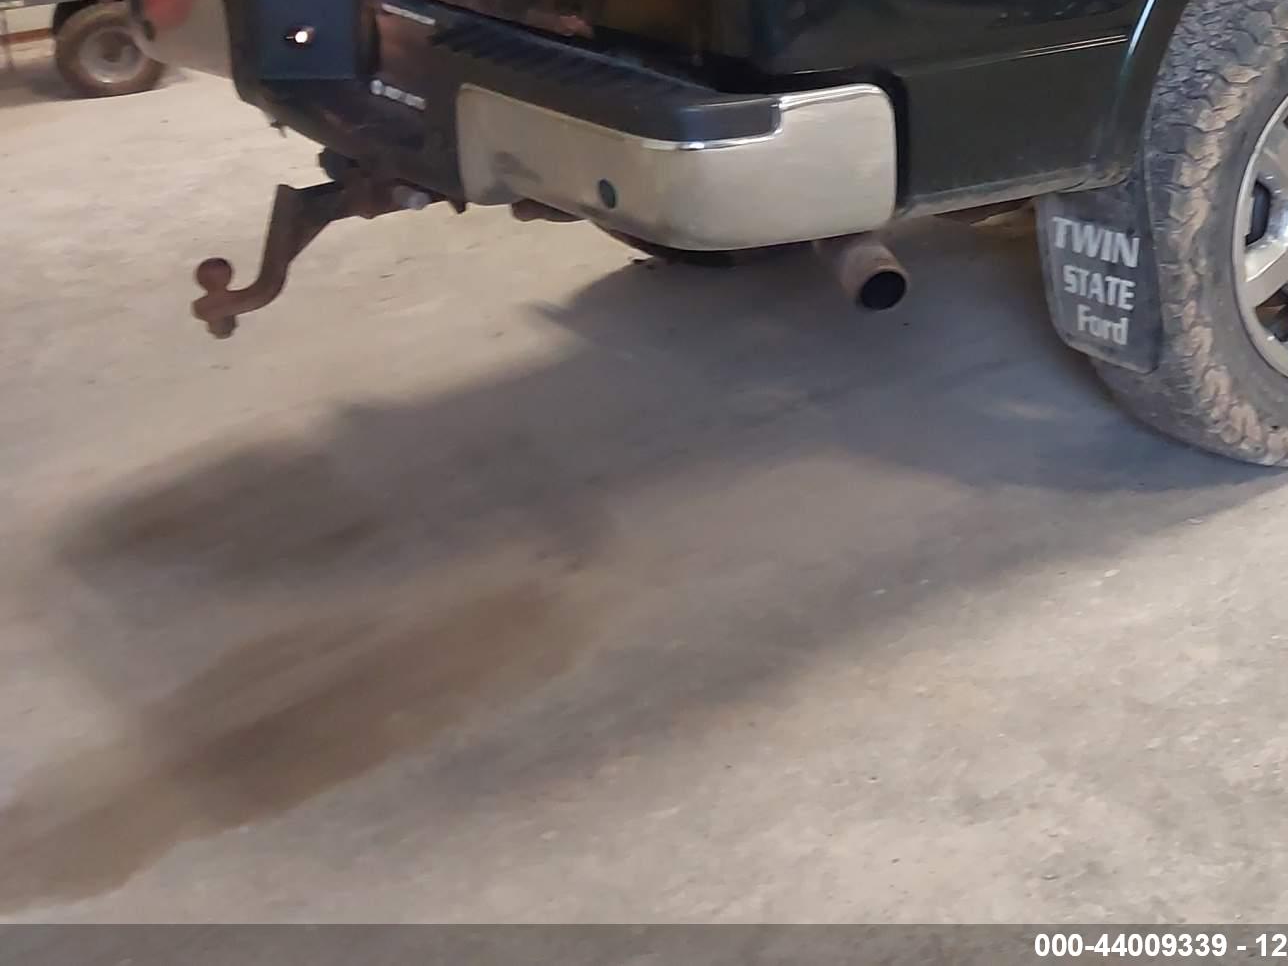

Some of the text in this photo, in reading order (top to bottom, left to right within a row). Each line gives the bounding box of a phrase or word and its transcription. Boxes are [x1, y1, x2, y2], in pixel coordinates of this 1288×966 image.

[1052, 216, 1141, 268] TWIN
[1063, 264, 1136, 311] STATE
[1077, 304, 1129, 346] Ford
